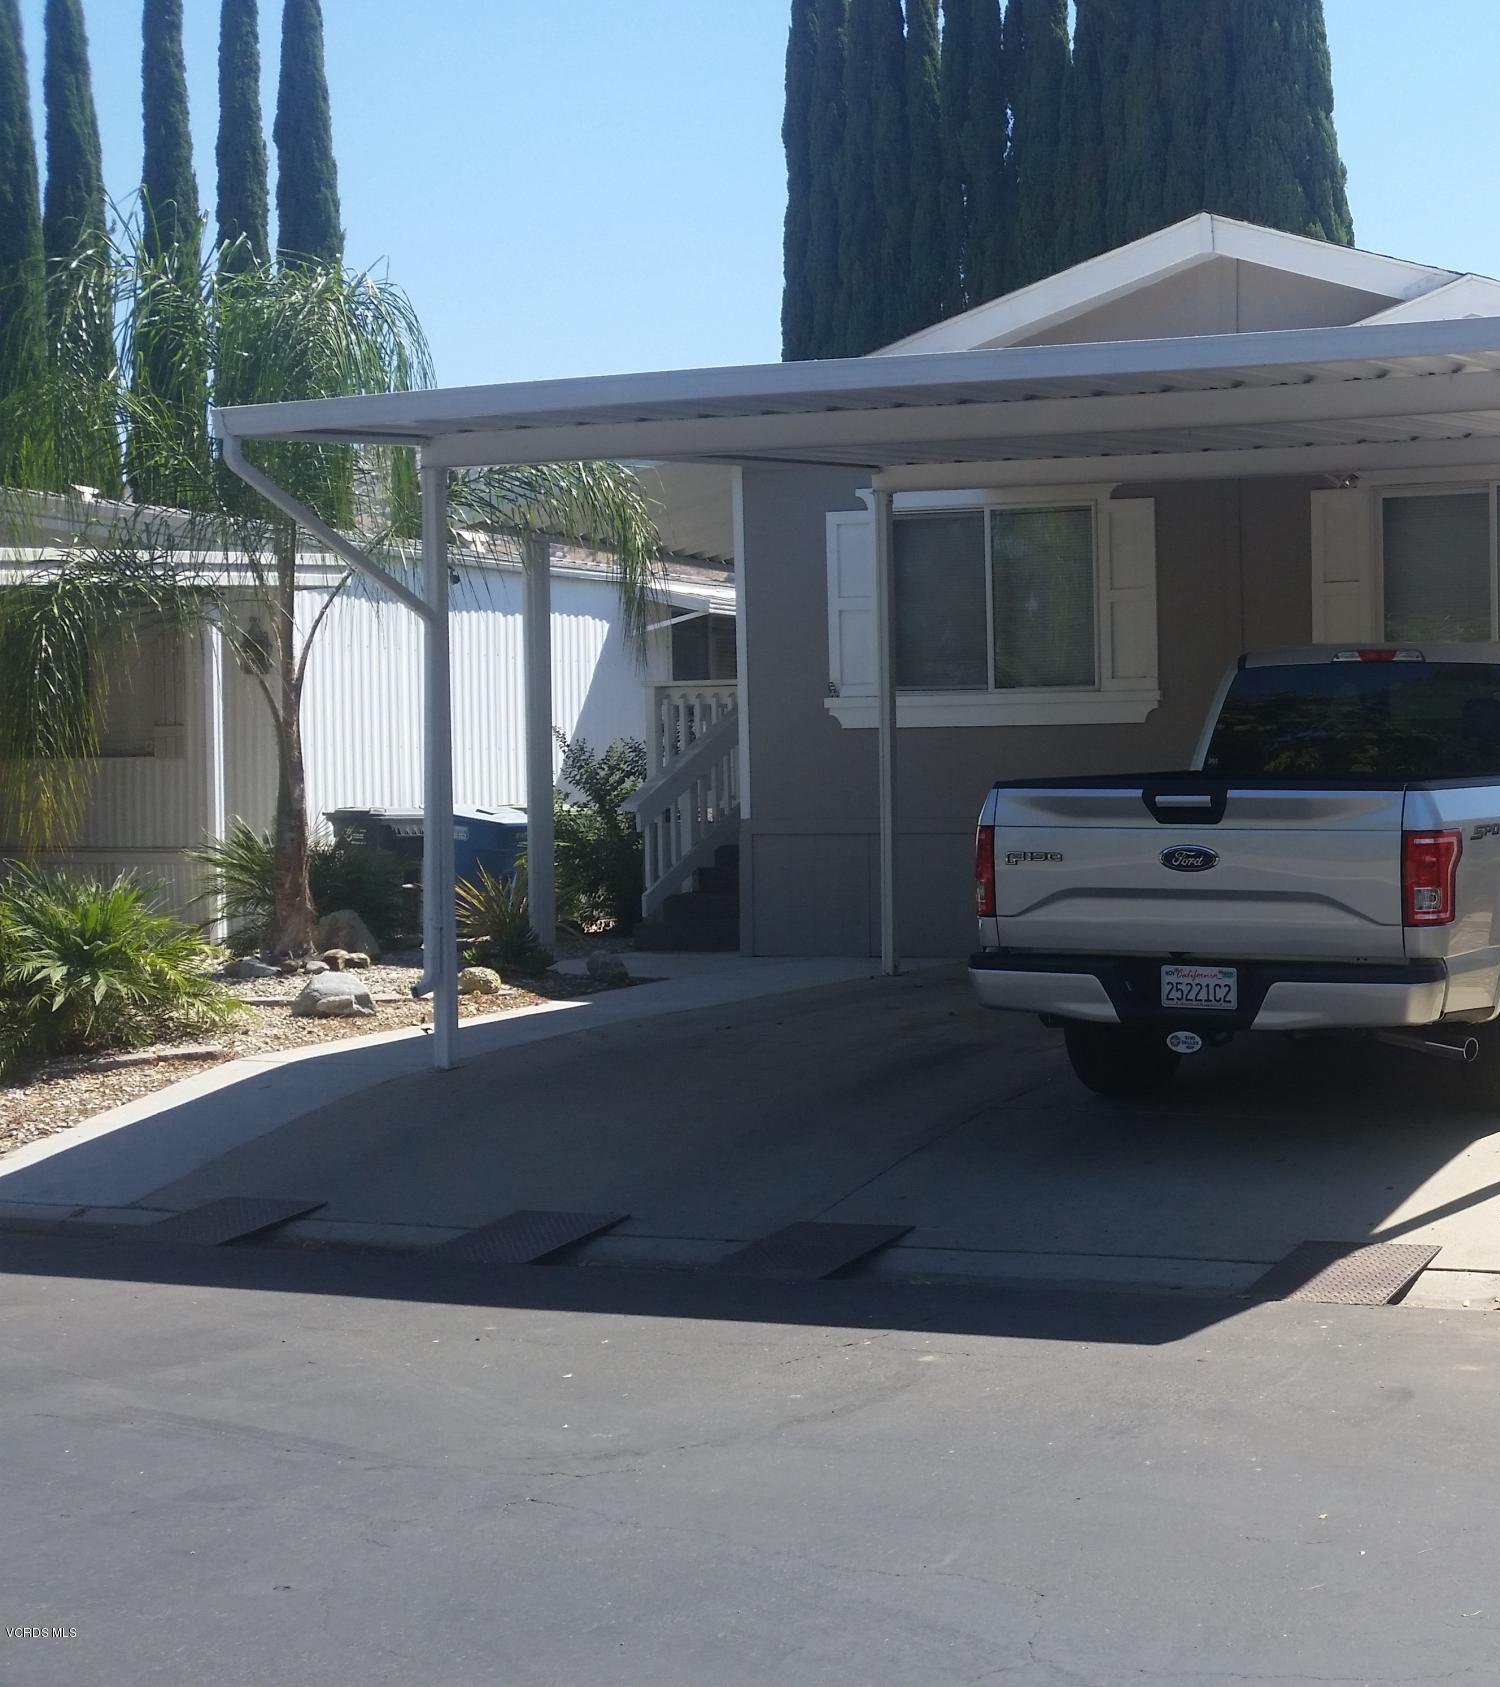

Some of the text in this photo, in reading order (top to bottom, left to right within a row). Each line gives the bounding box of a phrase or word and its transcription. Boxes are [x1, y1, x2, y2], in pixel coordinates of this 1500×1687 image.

[1172, 851, 1204, 866] Ford
[1176, 969, 1218, 981] California
[1166, 981, 1232, 1004] 25221C2
